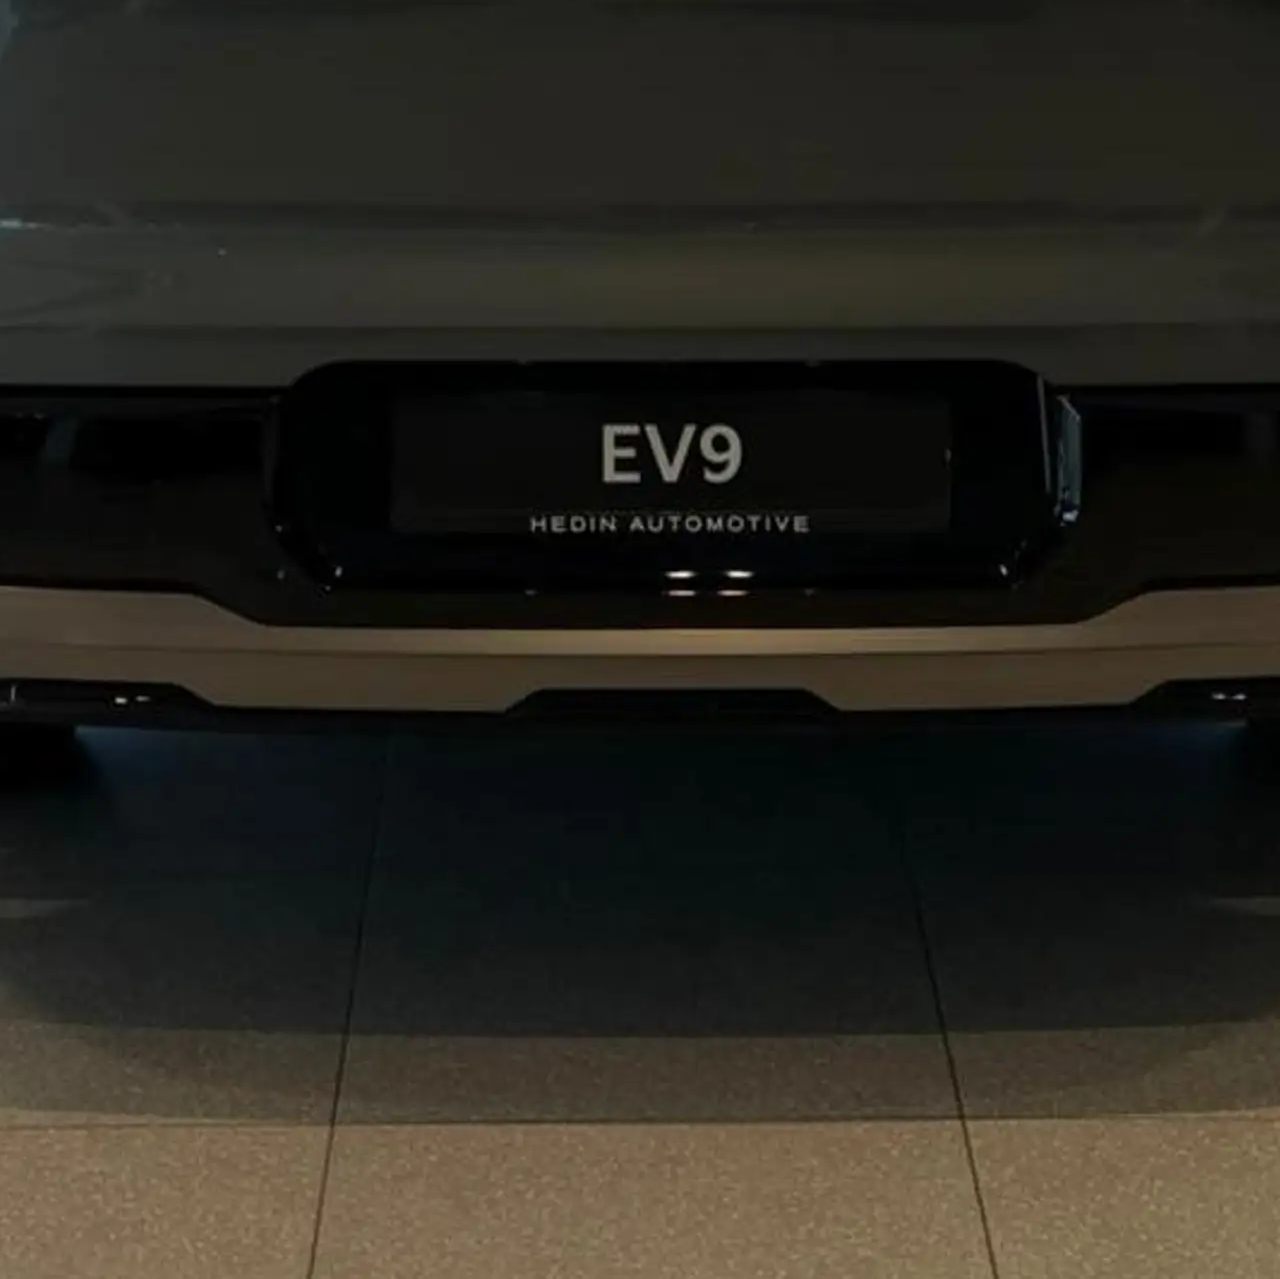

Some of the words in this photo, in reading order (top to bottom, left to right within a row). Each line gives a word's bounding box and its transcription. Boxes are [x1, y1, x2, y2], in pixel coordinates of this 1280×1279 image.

[602, 424, 742, 484] EV9
[530, 515, 617, 533] HEDIN
[629, 514, 810, 533] AUTOMOTIVE
